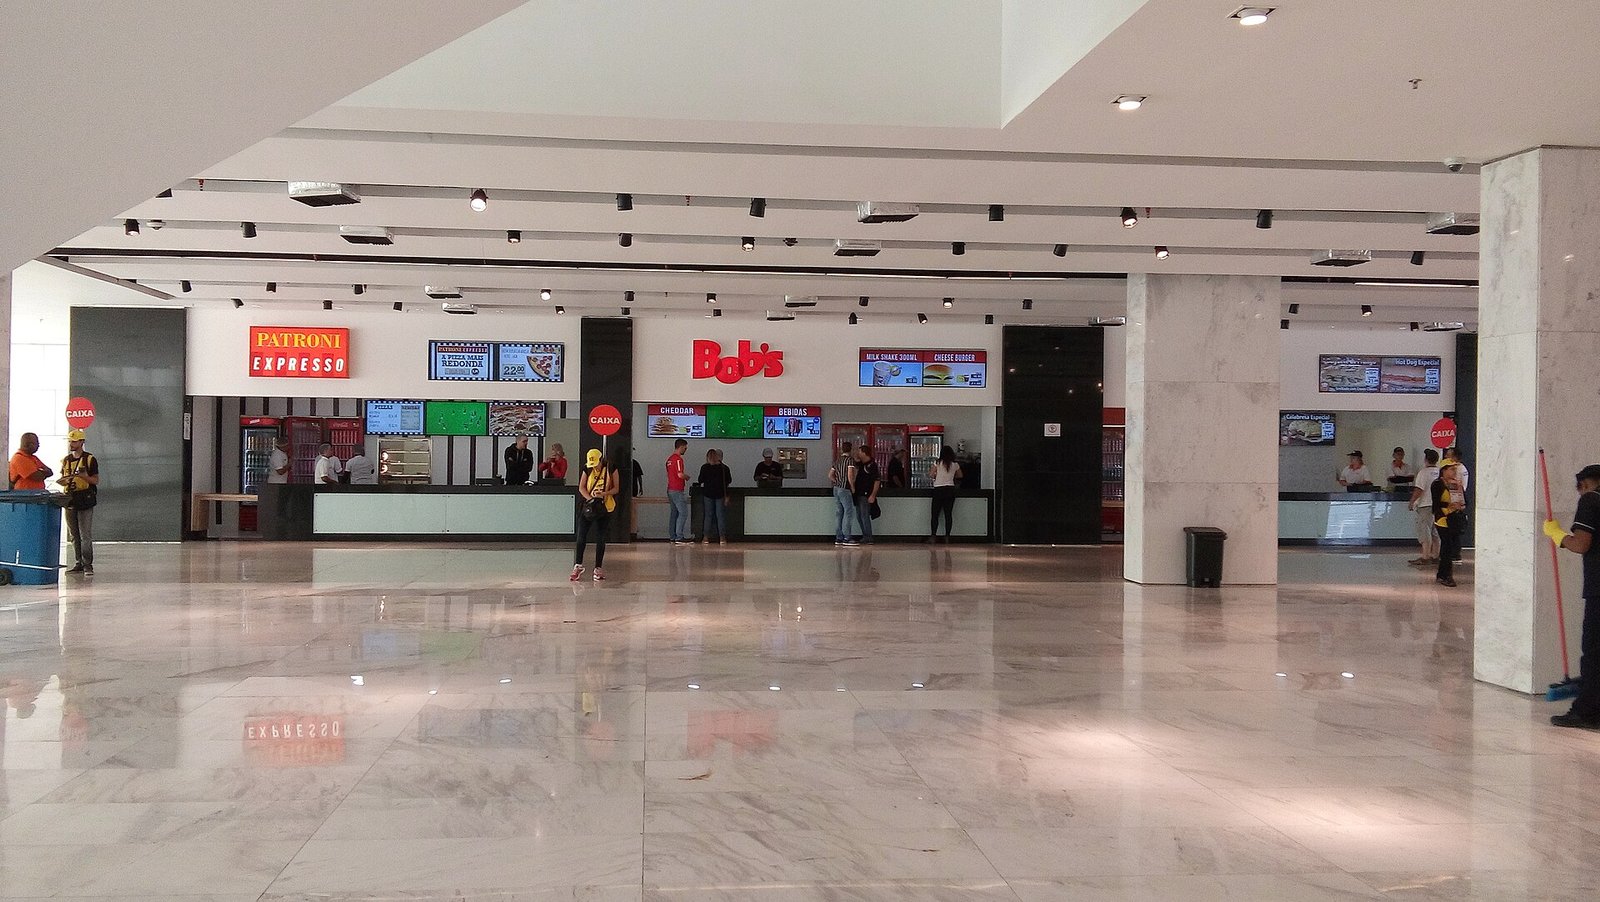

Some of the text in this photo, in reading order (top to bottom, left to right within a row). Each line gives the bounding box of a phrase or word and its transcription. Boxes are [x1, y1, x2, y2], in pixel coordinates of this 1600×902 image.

[256, 332, 341, 349] PATRONI
[881, 353, 898, 361] SHAKE
[934, 353, 954, 361] CHEESE
[253, 356, 344, 372] EXPRESSO
[441, 360, 484, 368] REDONDA
[692, 339, 784, 384] Bob's
[66, 410, 94, 418] CAIXA
[778, 408, 808, 416] BEBIDAS
[590, 416, 620, 424] CAIXA
[1431, 429, 1455, 438] CAIXA
